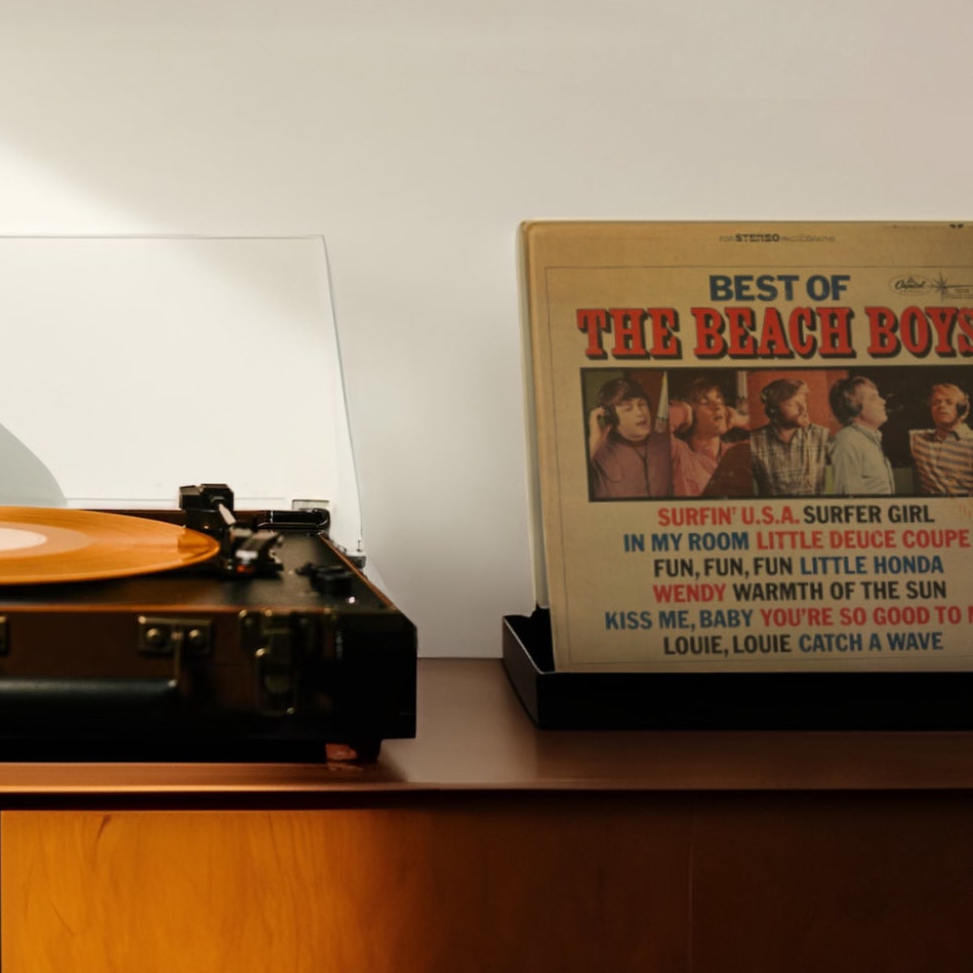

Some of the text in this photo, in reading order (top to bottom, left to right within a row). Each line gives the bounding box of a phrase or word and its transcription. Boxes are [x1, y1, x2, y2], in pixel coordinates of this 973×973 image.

[735, 233, 779, 243] STEREO
[709, 275, 851, 301] BEST OF
[576, 306, 973, 360] THE BEACH BOYS
[658, 505, 935, 527] SURFIN' U.S.A. SURFER GIRL
[624, 529, 971, 552] IN MY ROOM LITTLE DEUCE COUPE
[654, 556, 944, 579] FUN, FUN, FUN LITTLE HONDA
[653, 581, 947, 603] WENDY WARMTH OF THE SUN
[605, 611, 652, 630] KISS
[659, 610, 696, 632] ME,
[699, 609, 753, 628] BABY
[760, 607, 833, 627] YOU'RE
[840, 607, 866, 626] SO
[873, 606, 930, 626] GOOD
[934, 606, 961, 625] TO
[664, 632, 944, 657] LOUIE, LOUIE CATCH A WAVE
